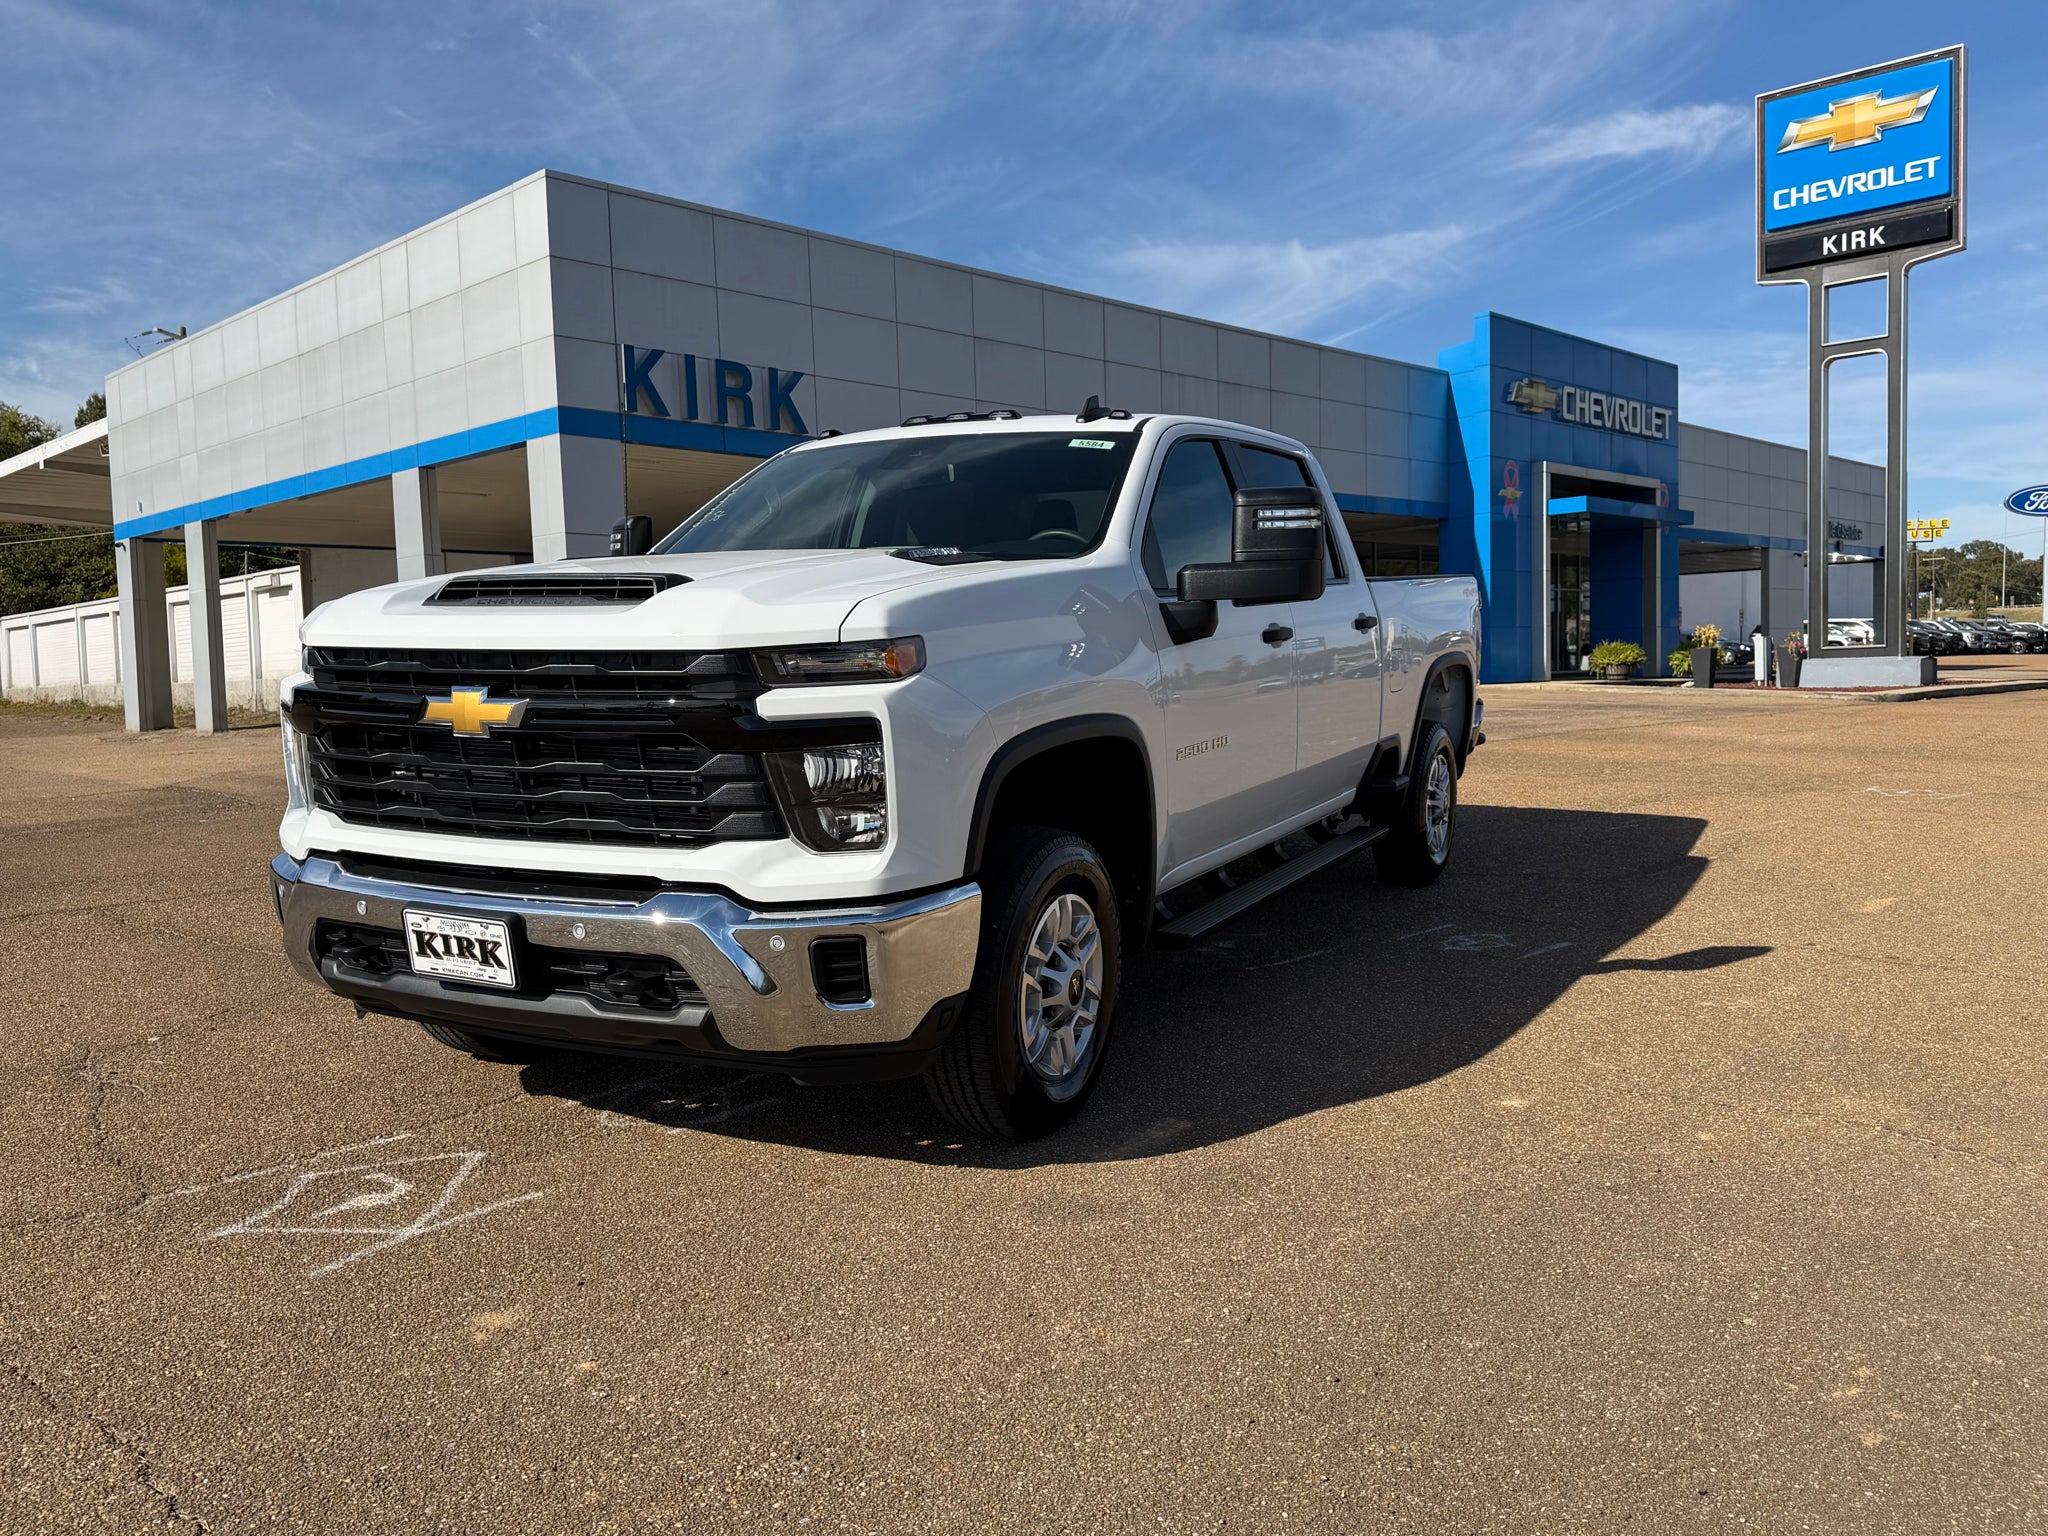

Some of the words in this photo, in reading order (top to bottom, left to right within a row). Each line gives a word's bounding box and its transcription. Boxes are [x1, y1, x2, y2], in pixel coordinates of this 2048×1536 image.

[1773, 156, 1941, 211] CHEVROLET
[1822, 225, 1886, 256] KIRK
[621, 343, 809, 435] KIRK
[1562, 385, 1673, 440] CHEVROLET
[1078, 440, 1104, 448] 5584
[1175, 740, 1211, 762] 2500
[1212, 734, 1231, 751] HD
[411, 929, 507, 970] KIRK
